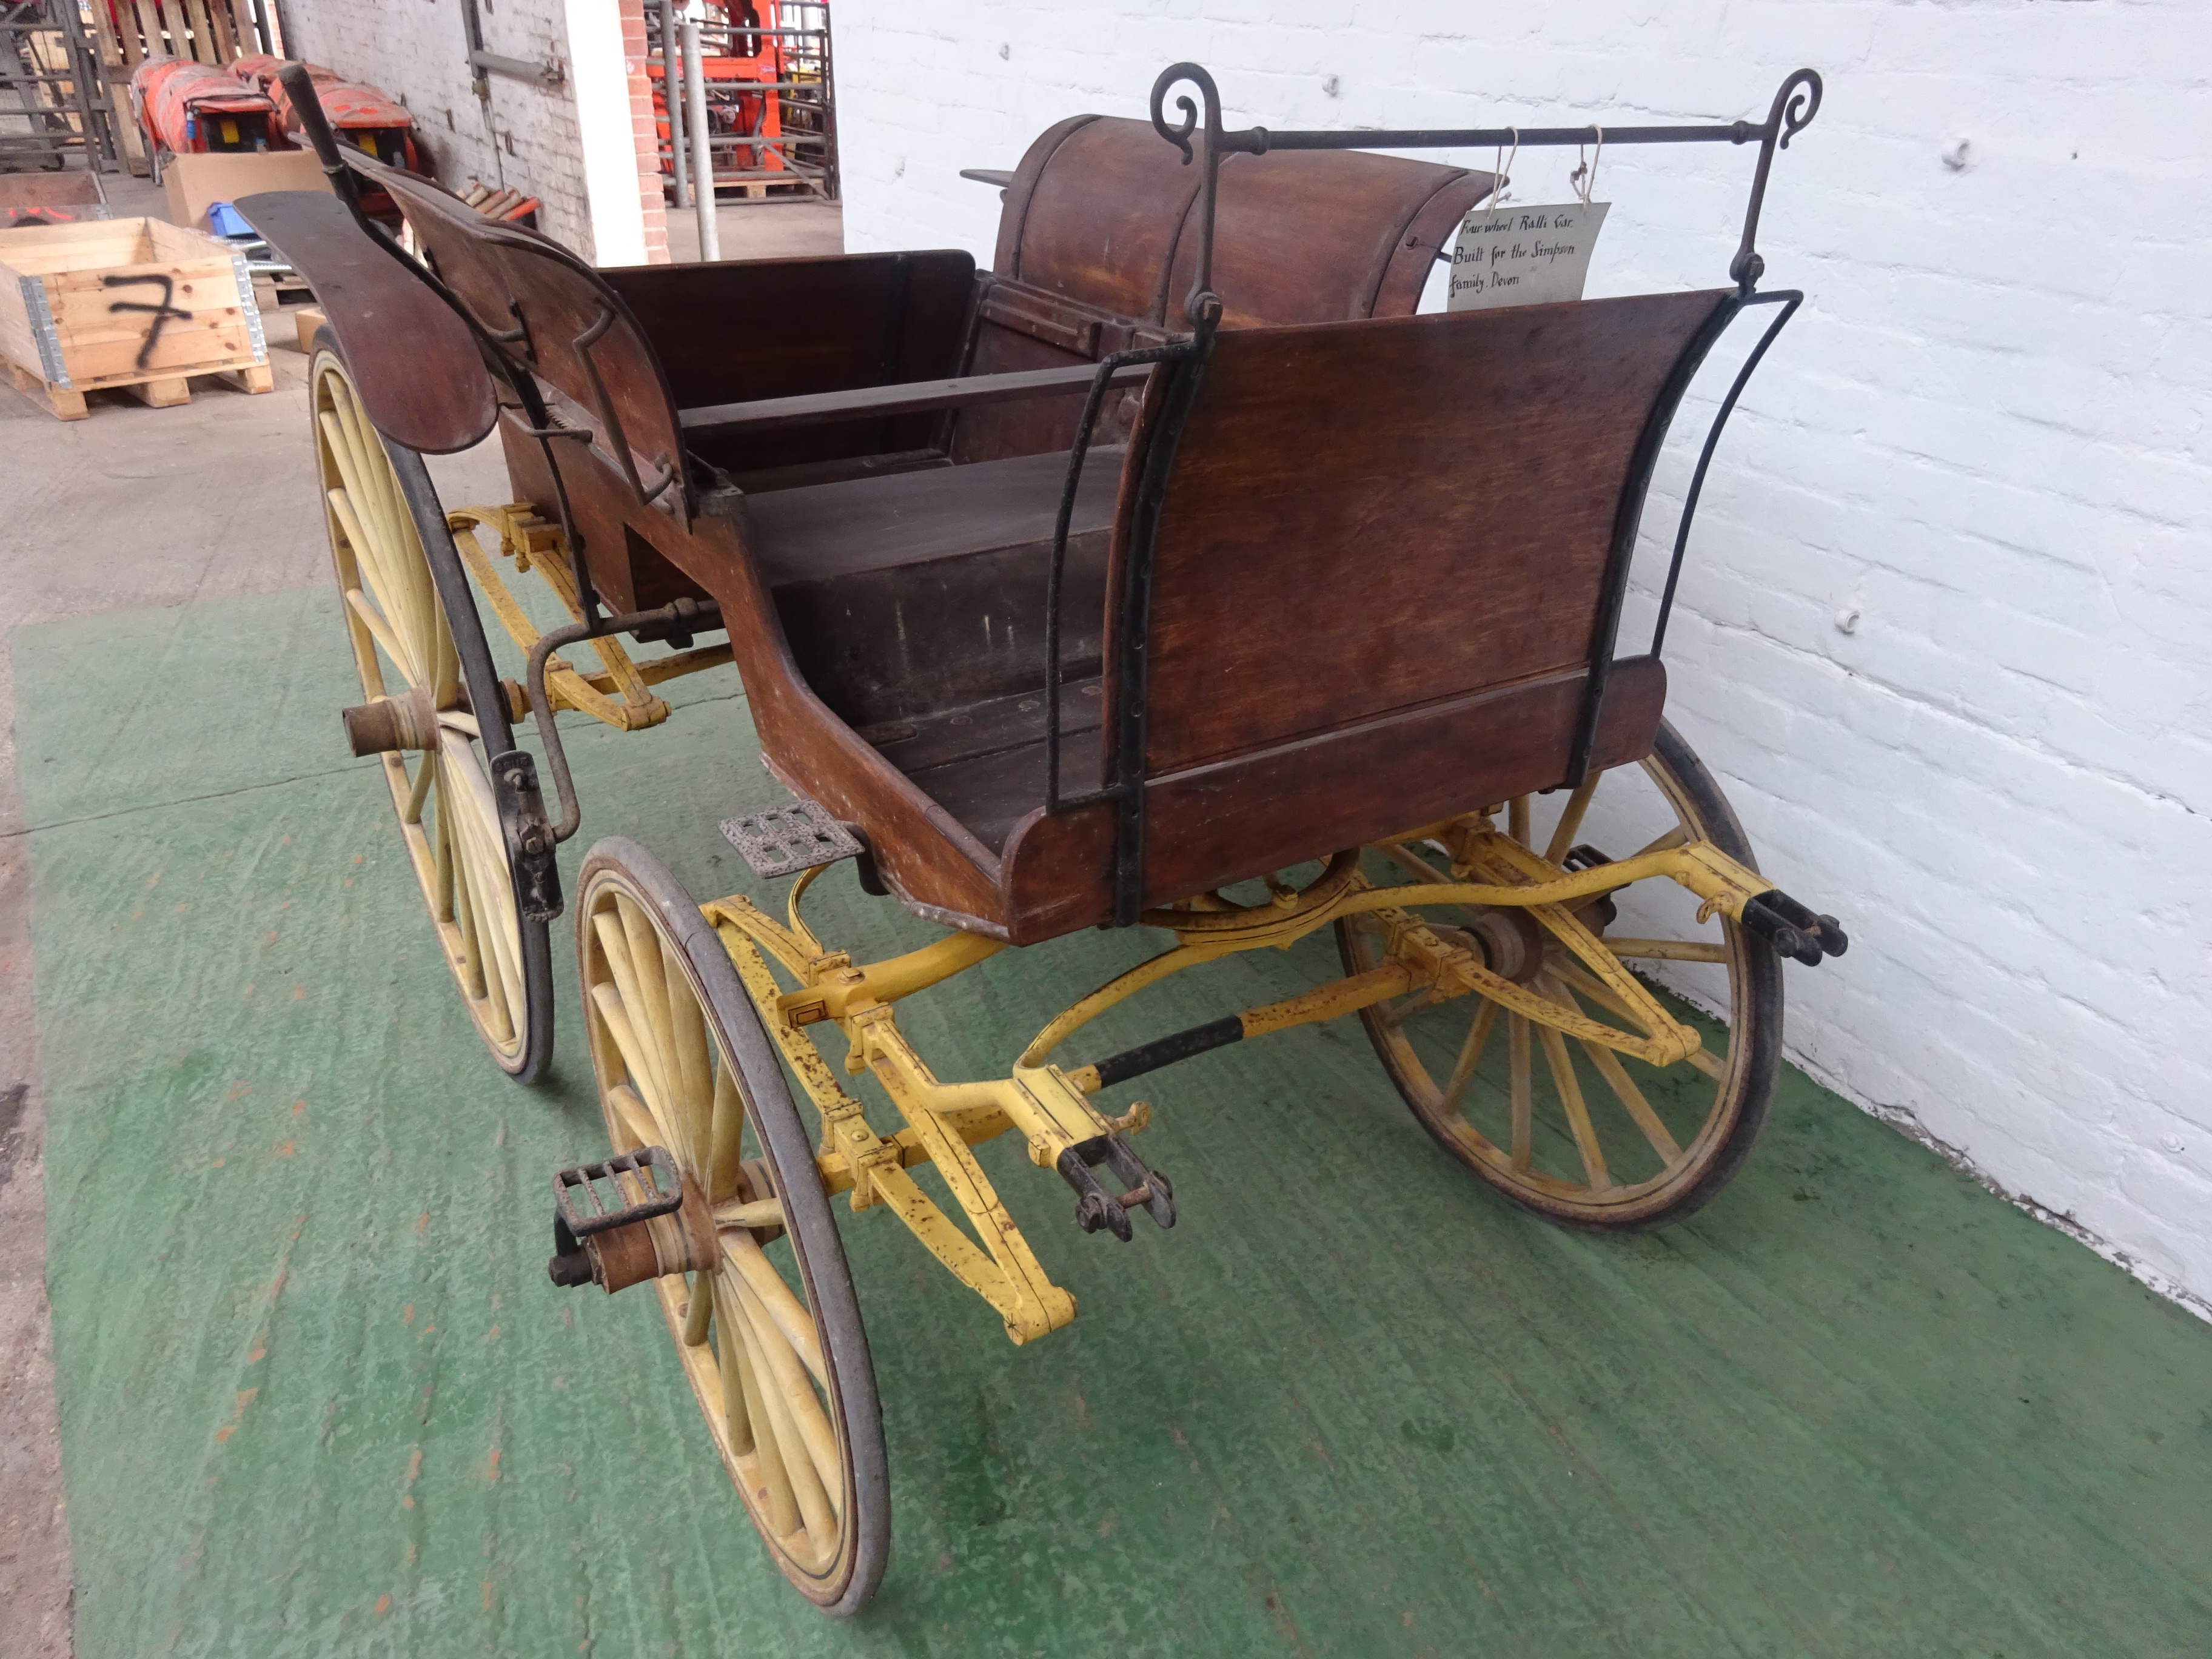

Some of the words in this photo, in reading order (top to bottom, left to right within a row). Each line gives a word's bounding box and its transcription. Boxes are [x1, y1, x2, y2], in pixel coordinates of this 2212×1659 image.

[1520, 215, 1547, 230] Ralli
[1453, 246, 1484, 266] Built
[1491, 246, 1506, 267] for
[1511, 243, 1527, 259] the
[1531, 240, 1575, 264] Simpson
[1491, 272, 1519, 287] Devon
[104, 275, 192, 369] 7
